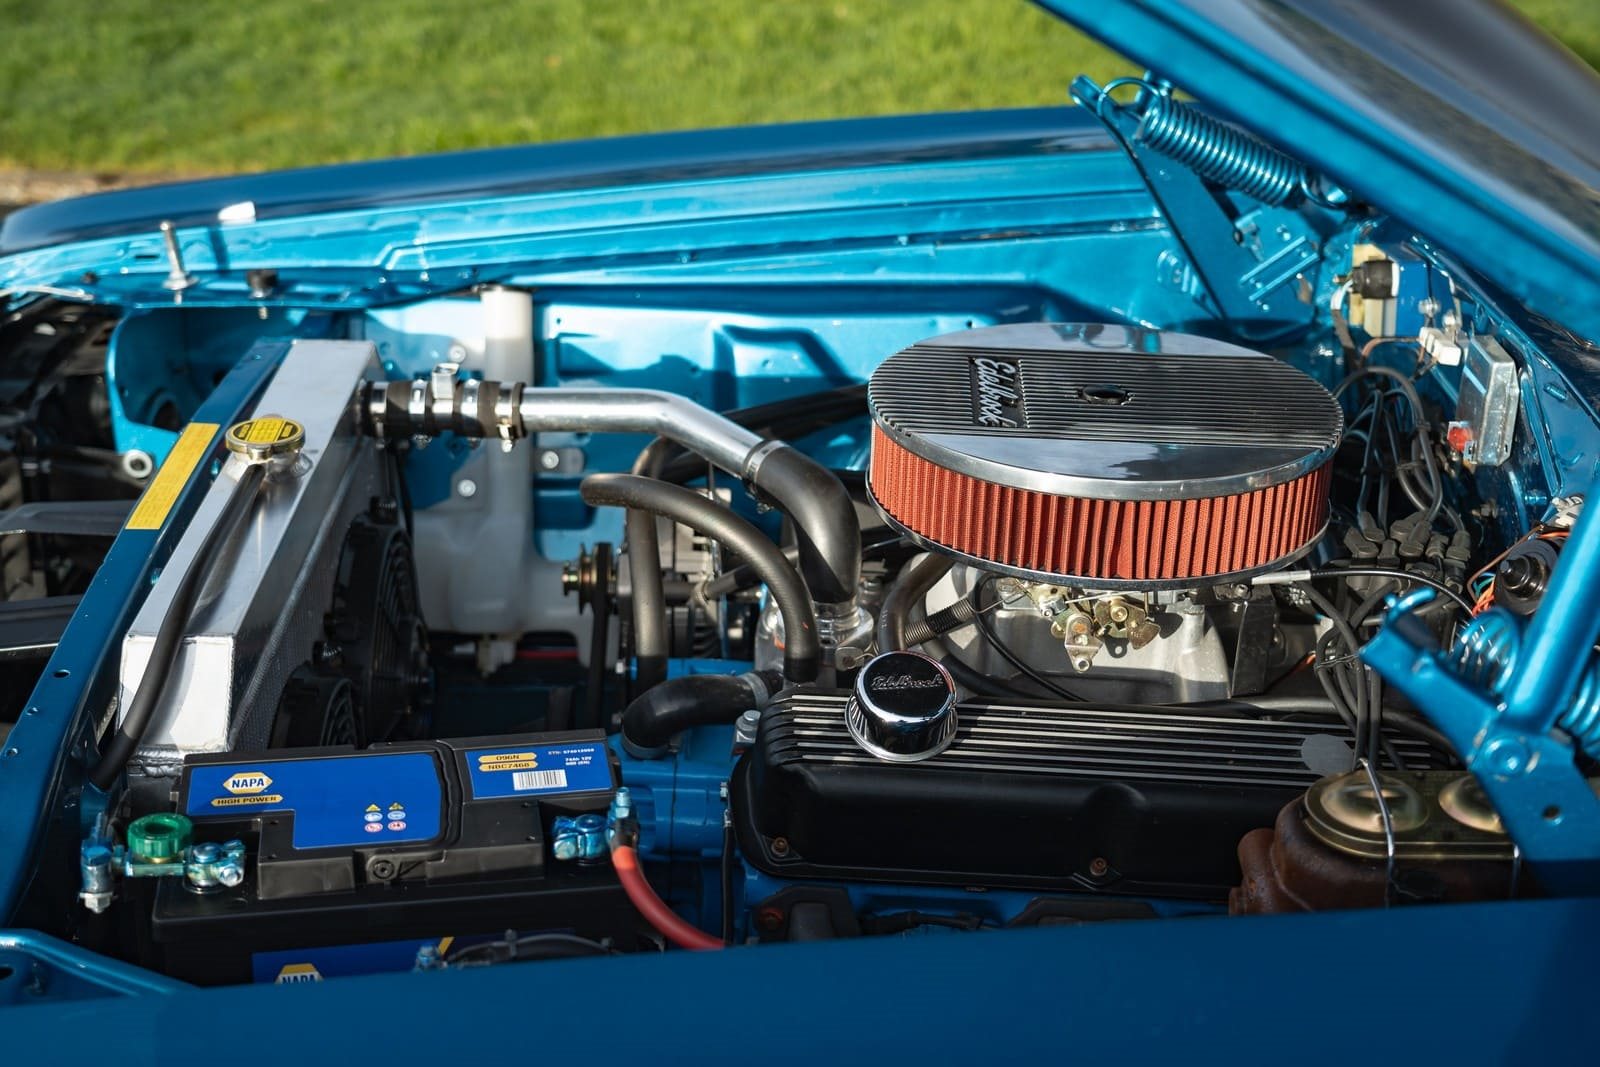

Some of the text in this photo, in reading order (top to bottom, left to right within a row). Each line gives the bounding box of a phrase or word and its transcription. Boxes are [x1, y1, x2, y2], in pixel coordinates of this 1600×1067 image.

[974, 358, 1018, 427] Edelbrock
[231, 778, 265, 788] NAPA
[217, 796, 277, 806] HIGH POWER
